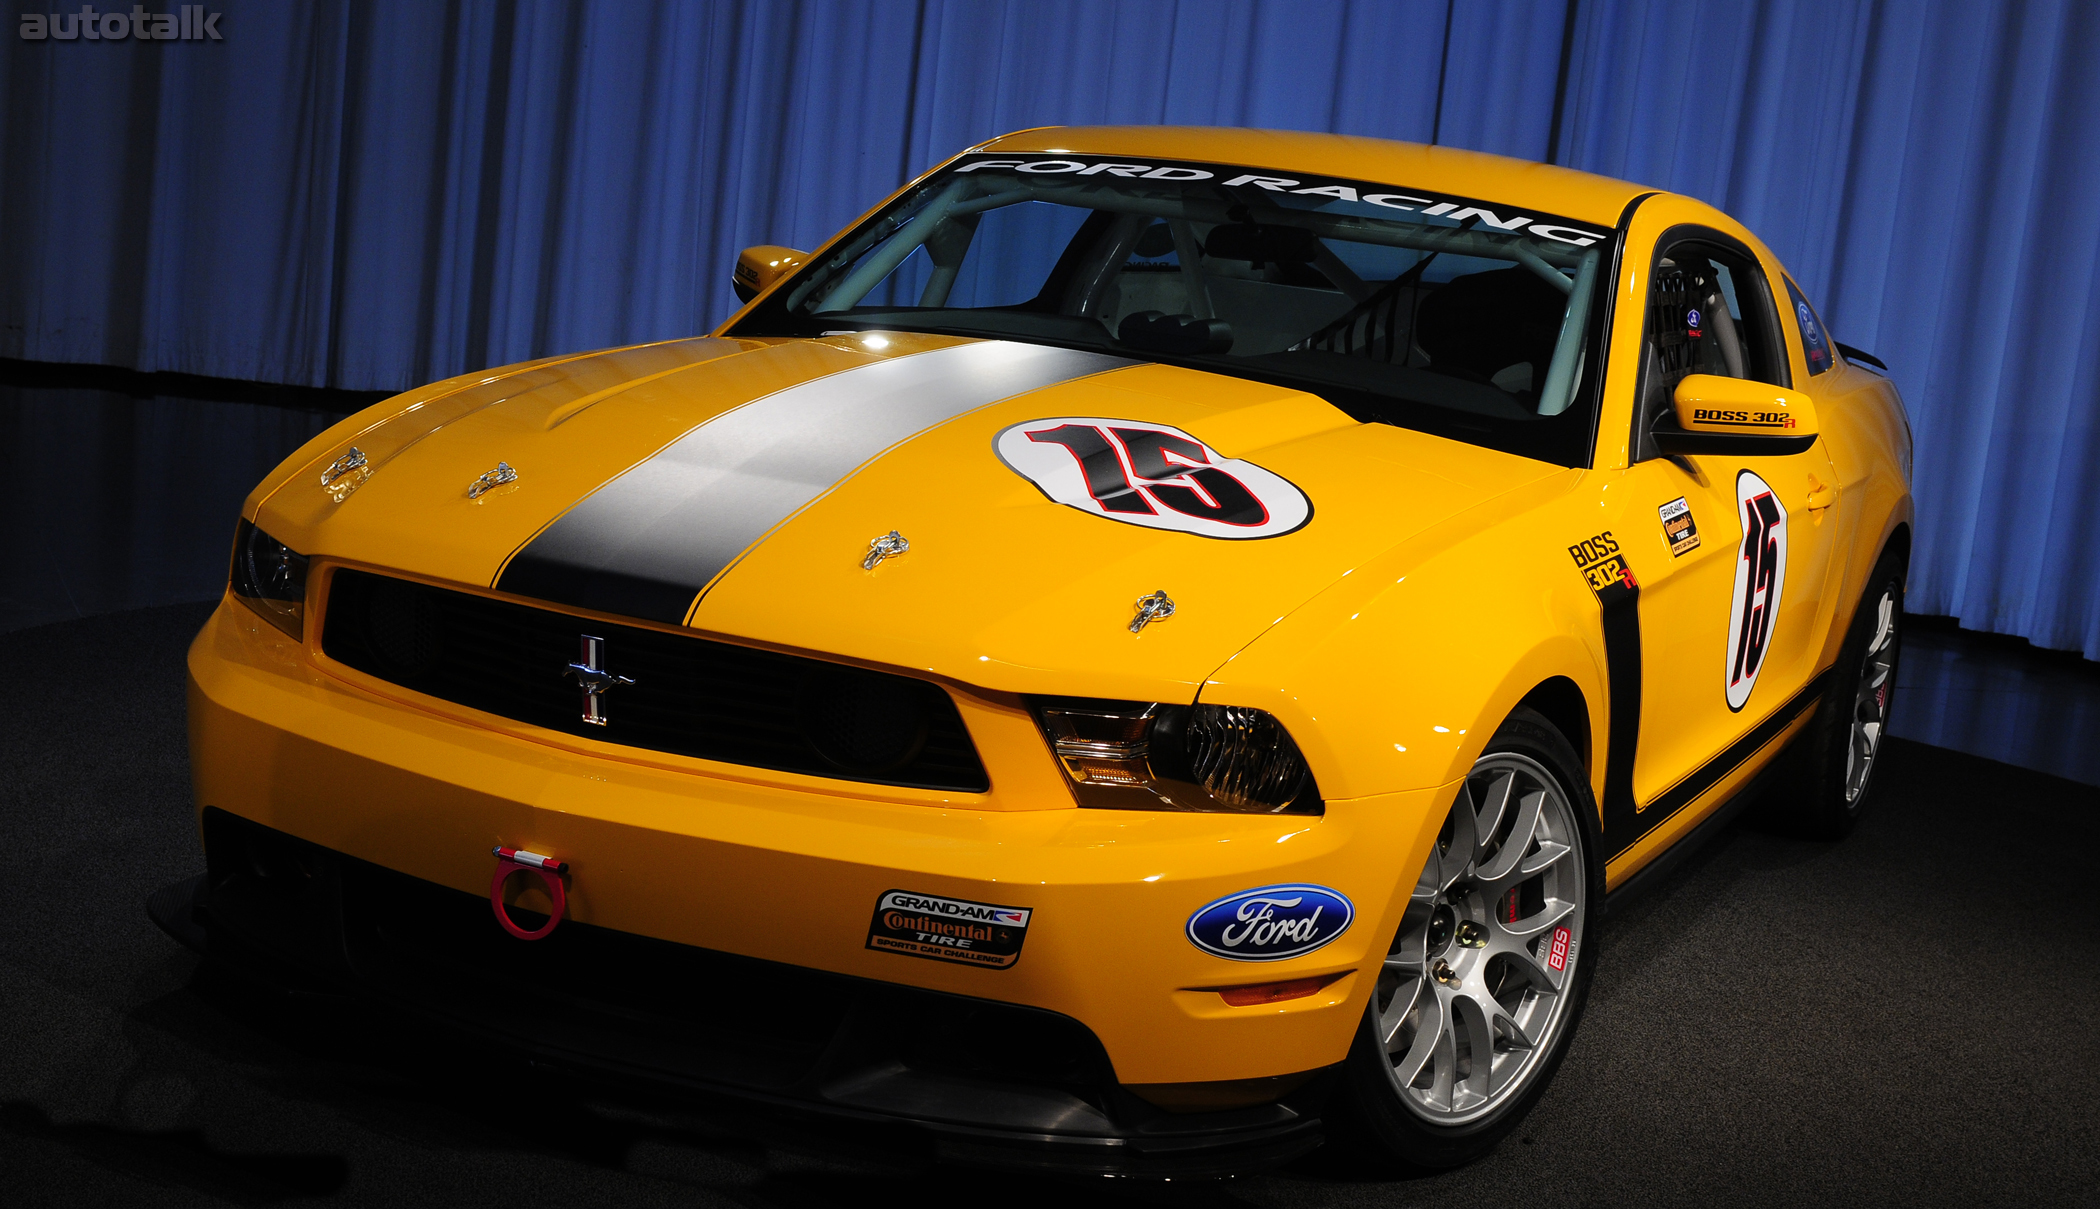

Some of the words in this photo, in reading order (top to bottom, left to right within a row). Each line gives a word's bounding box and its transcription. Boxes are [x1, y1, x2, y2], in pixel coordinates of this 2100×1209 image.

[954, 160, 1214, 181] FORD
[1221, 174, 1606, 247] RACING
[1694, 409, 1748, 422] BOSS
[1024, 424, 1270, 527] 15
[1568, 531, 1620, 568] BOSS
[1730, 491, 1780, 688] 15
[883, 911, 993, 942] Continental
[891, 895, 994, 921] GRAND-AM
[1222, 897, 1324, 947] Ford
[876, 938, 918, 951] SPORTS
[919, 945, 942, 955] CAR
[944, 949, 1005, 964] CHALLENGE
[915, 932, 973, 949] TIRE
[1550, 928, 1568, 969] BBS
